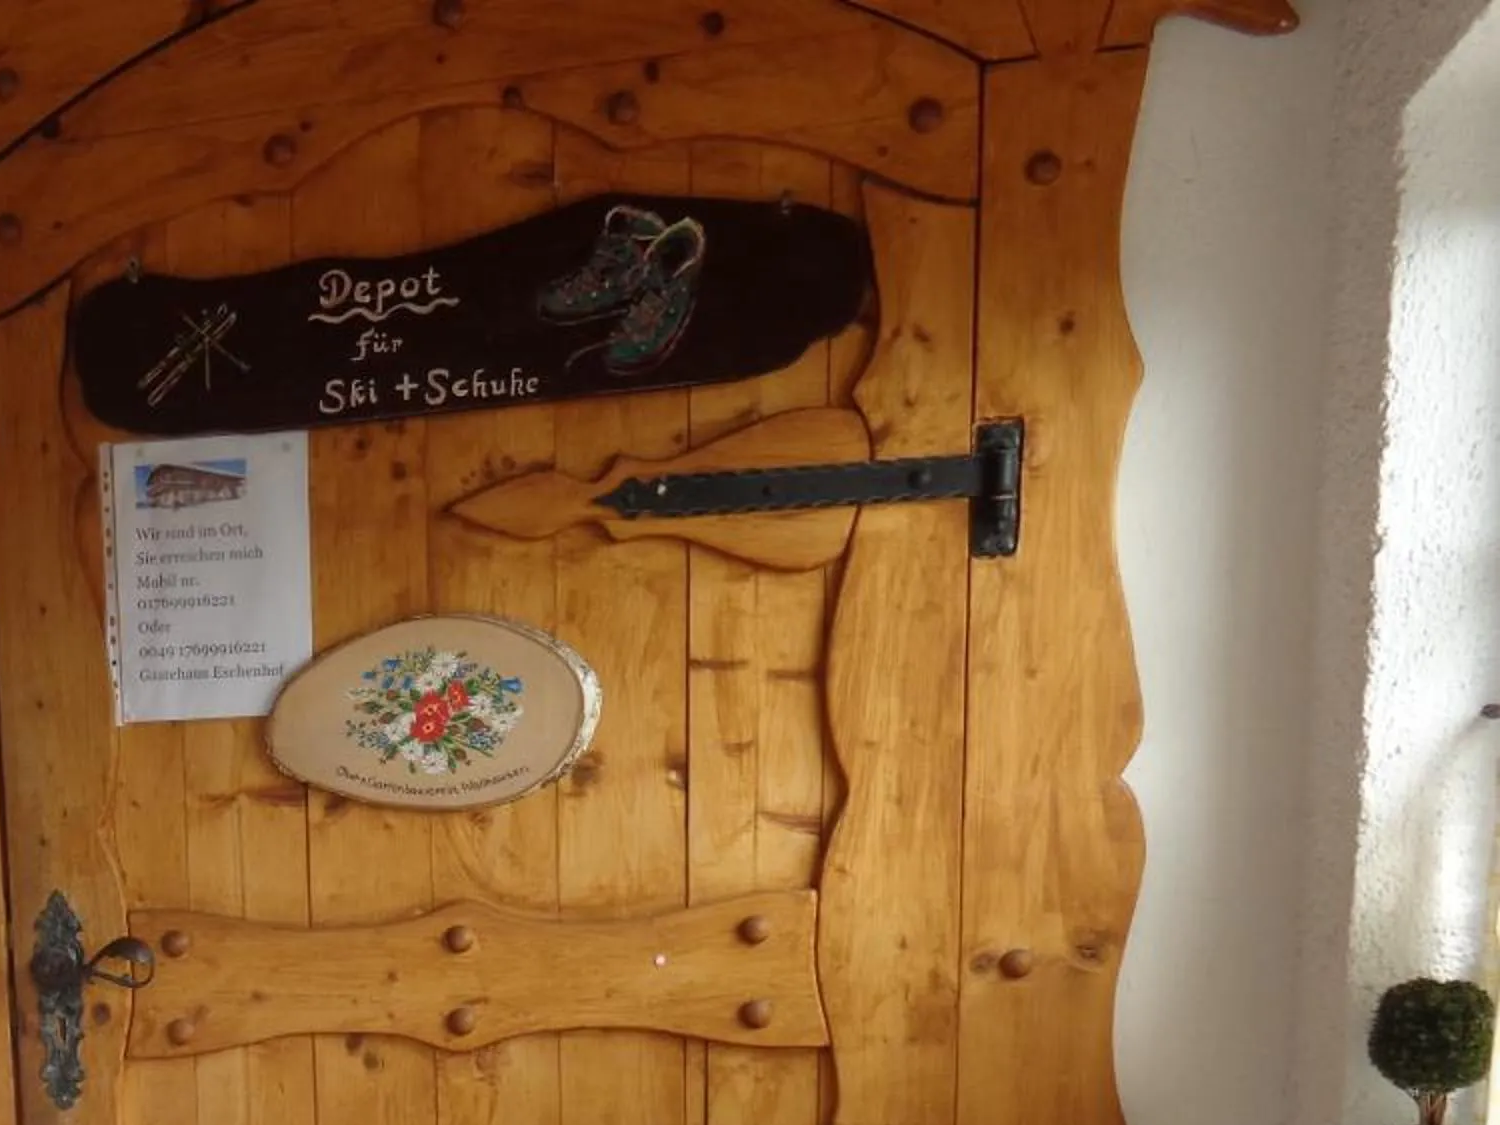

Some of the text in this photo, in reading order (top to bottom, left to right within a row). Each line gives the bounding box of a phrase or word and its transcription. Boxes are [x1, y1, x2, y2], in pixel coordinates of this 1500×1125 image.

[318, 265, 442, 313] Depot
[350, 327, 404, 361] für
[318, 367, 541, 415] Ski + Schuhe
[135, 526, 161, 542] Wir
[135, 543, 264, 566] Sie erreichen mich
[136, 572, 177, 590] Mobil
[137, 618, 172, 635] Oder
